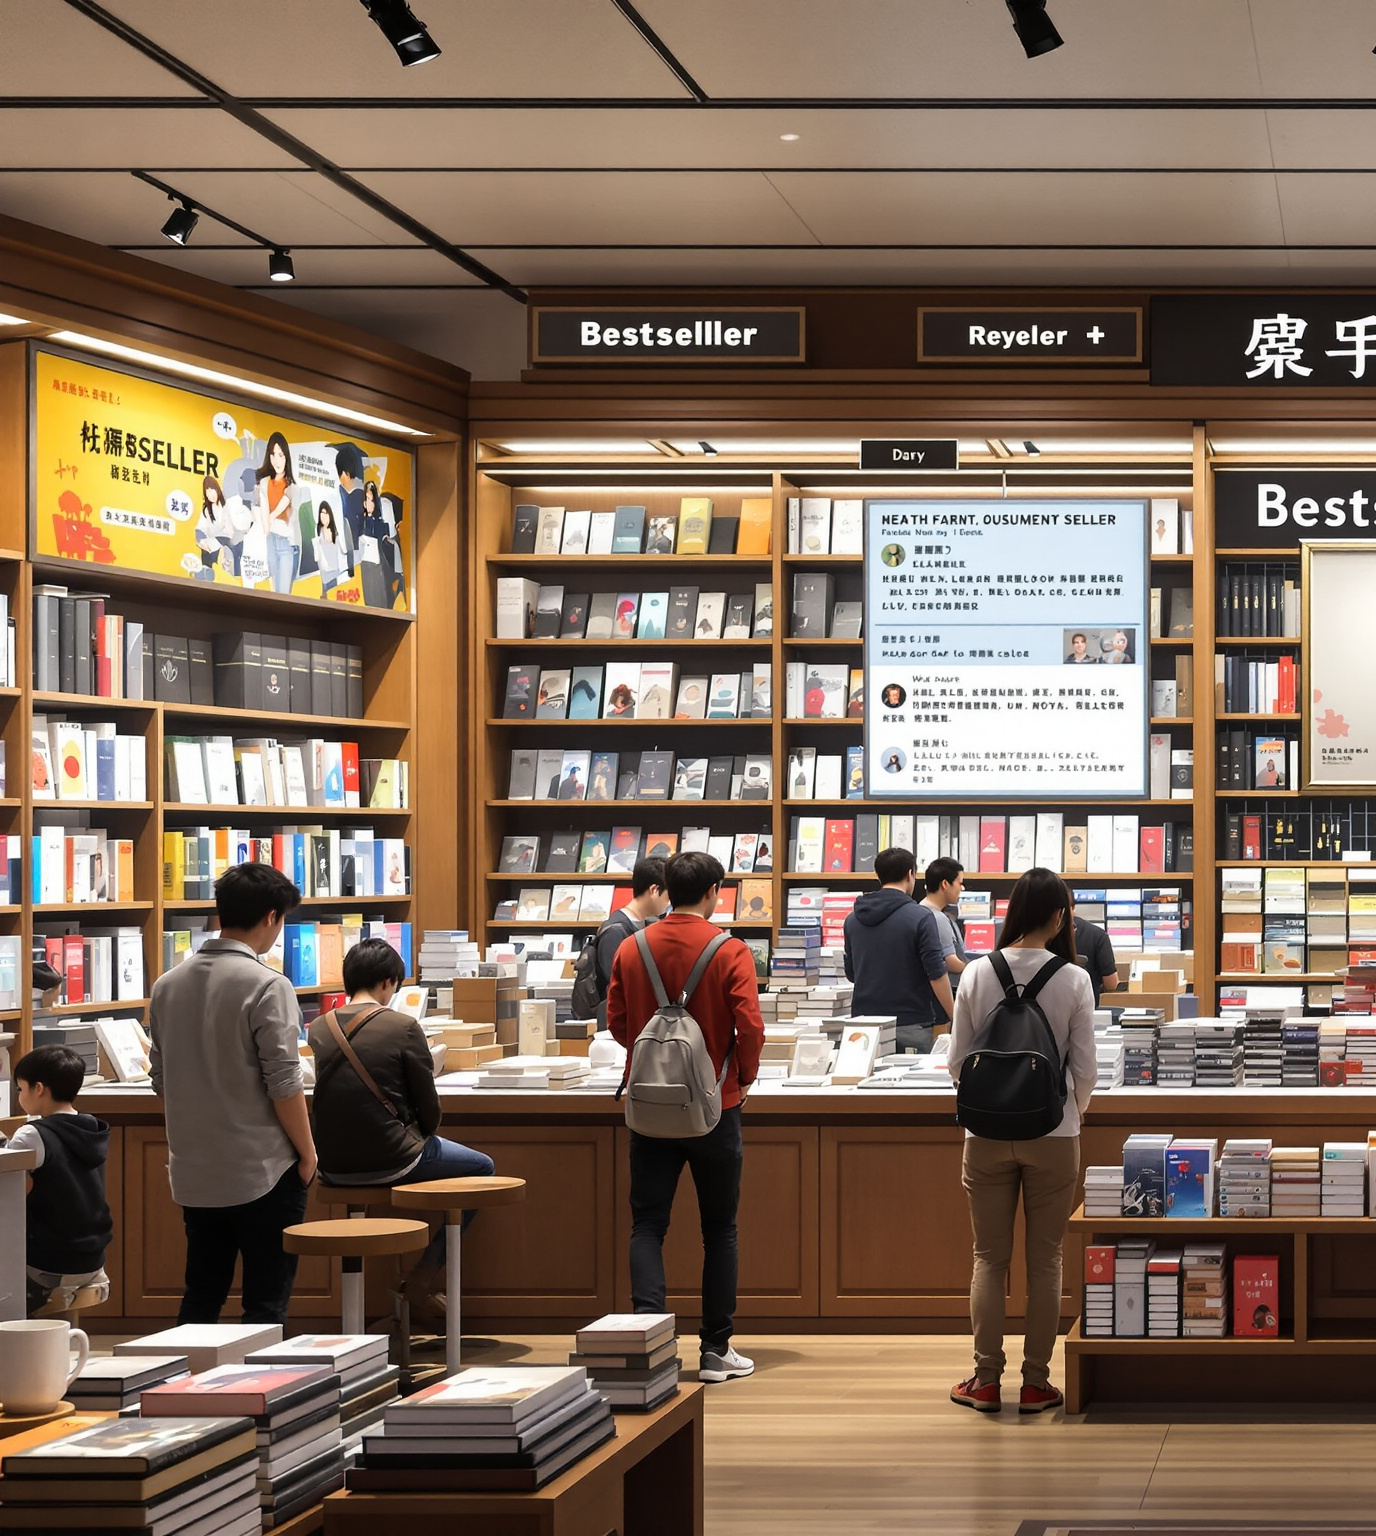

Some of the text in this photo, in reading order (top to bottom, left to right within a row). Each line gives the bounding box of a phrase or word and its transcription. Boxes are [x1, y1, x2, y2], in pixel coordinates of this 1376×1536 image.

[580, 320, 758, 347] Bestselller
[969, 324, 1068, 350] Reyeler
[892, 448, 926, 464] Dary
[983, 514, 1060, 526] OUSUMENT
[1064, 514, 1117, 526] SELLER
